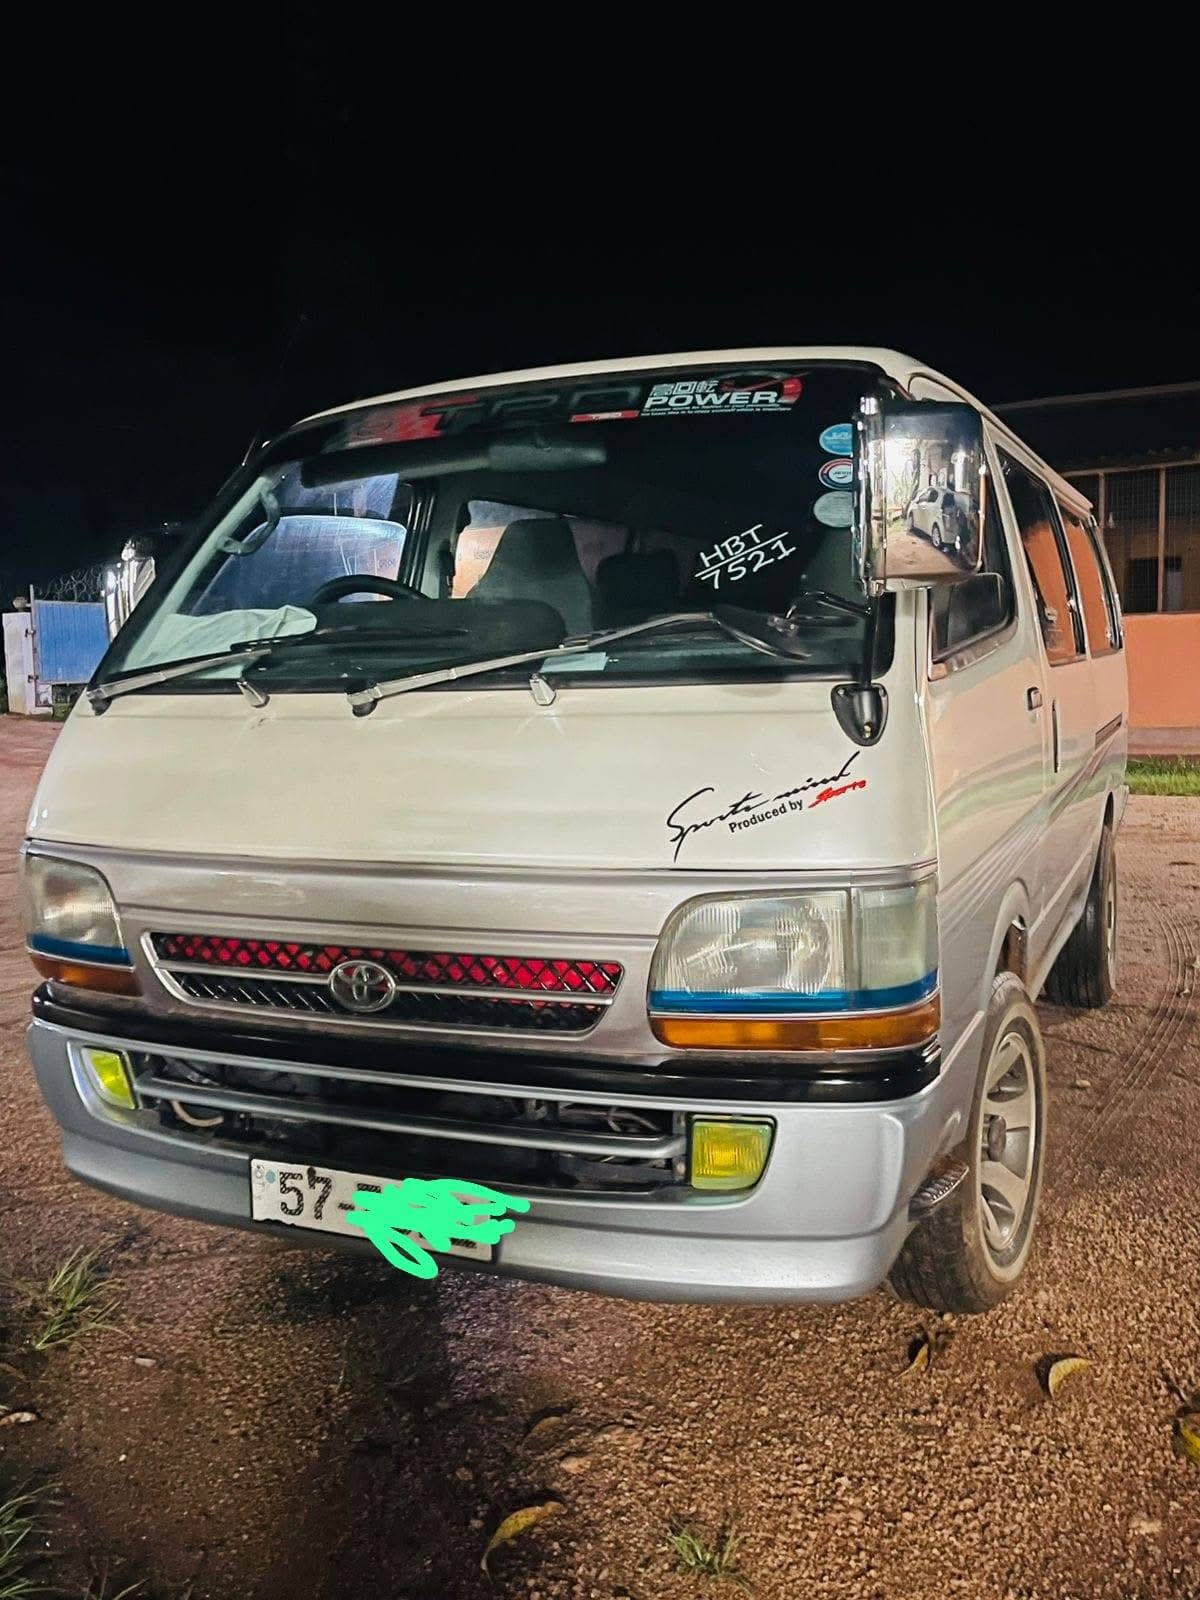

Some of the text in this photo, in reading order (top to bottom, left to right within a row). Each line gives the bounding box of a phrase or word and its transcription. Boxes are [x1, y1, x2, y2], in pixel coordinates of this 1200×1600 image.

[644, 391, 779, 409] POWER
[700, 523, 763, 568] HBT
[701, 540, 796, 589] 7521
[728, 805, 788, 833] Produced
[789, 799, 804, 811] by
